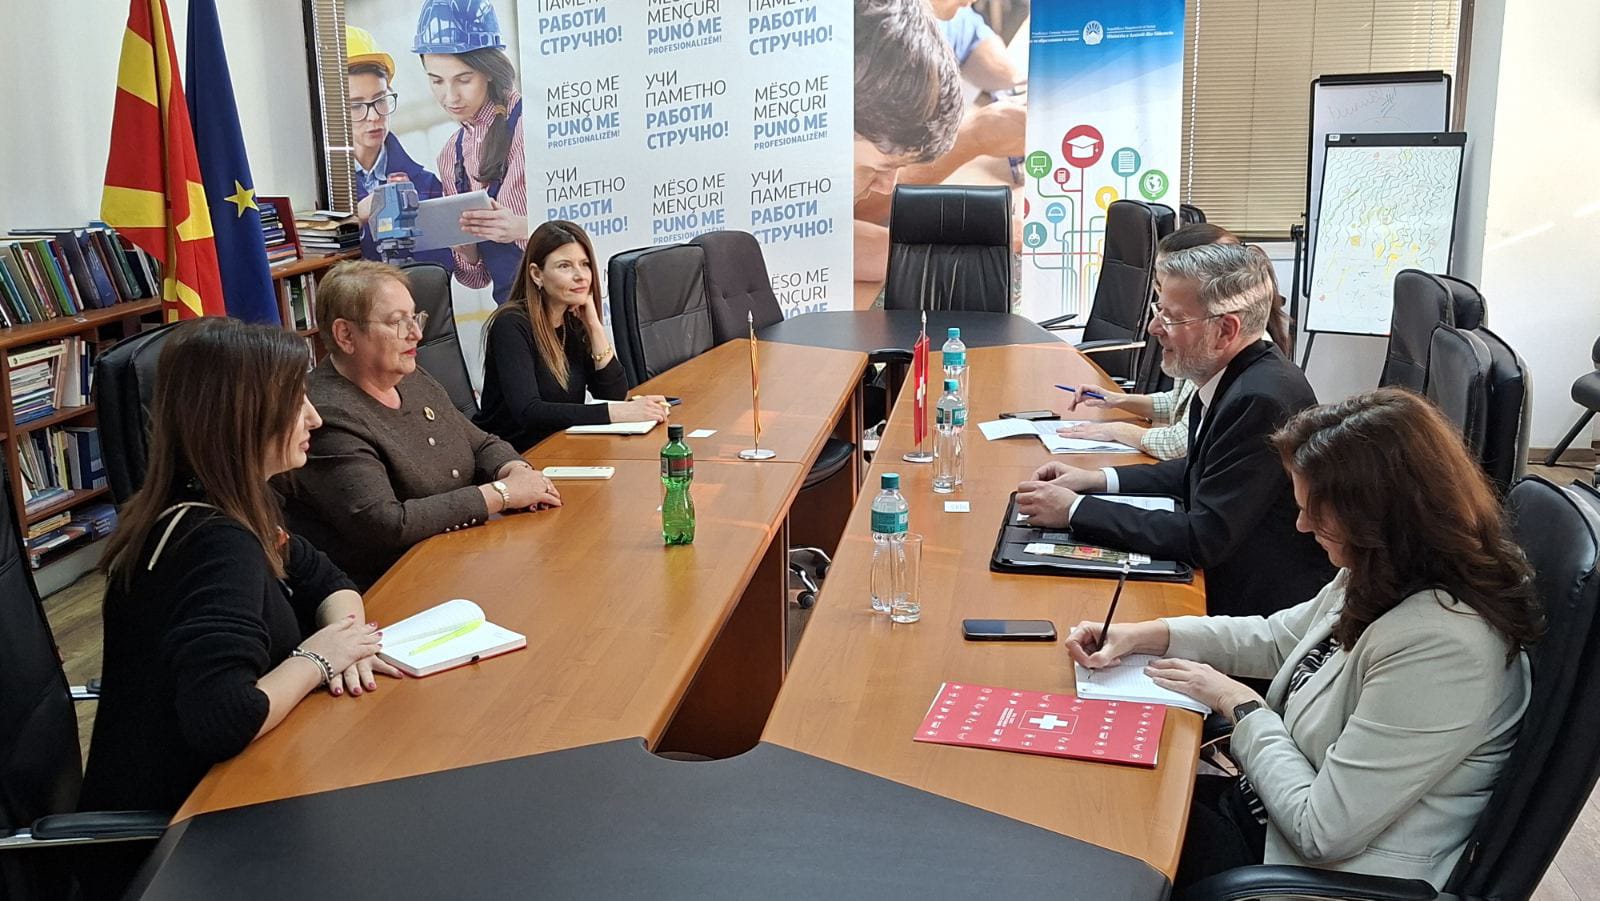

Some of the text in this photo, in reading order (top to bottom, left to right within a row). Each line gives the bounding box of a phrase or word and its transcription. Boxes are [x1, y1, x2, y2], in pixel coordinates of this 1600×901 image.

[539, 7, 606, 35] РАБОТИ
[648, 0, 720, 25] MENÇURI
[698, 16, 722, 36] ME
[749, 6, 817, 35] РАБОТИ
[540, 25, 622, 55] СТРУЧНО!
[749, 24, 832, 55] СТРУЧНО!
[547, 75, 620, 102] MËSO ME
[646, 70, 677, 90] УЧИ
[646, 79, 726, 108] ПАМЕТНО
[755, 75, 829, 103] MËSO ME
[547, 93, 618, 120] MENÇURI
[646, 102, 713, 129] РАБОТИ
[754, 94, 826, 121] MENÇURI
[596, 111, 620, 131] ME
[754, 112, 828, 140] PUNO ME
[548, 130, 621, 149] PROFESIONALIZËM!
[647, 120, 729, 150] СТРУЧНО!
[545, 166, 577, 186] УЧИ
[546, 176, 625, 203] ПАМЕТНО
[653, 172, 726, 199] MËSO ME
[751, 168, 783, 187] УЧИ
[653, 191, 723, 216] MENÇURI
[751, 178, 831, 205] ПАМЕТНО
[547, 198, 612, 221] РАБОТИ
[653, 208, 725, 235] PUNO ME
[751, 199, 818, 226] РАБОТИ
[771, 267, 829, 289] ËSO ME
[774, 285, 827, 307] NÇURI
